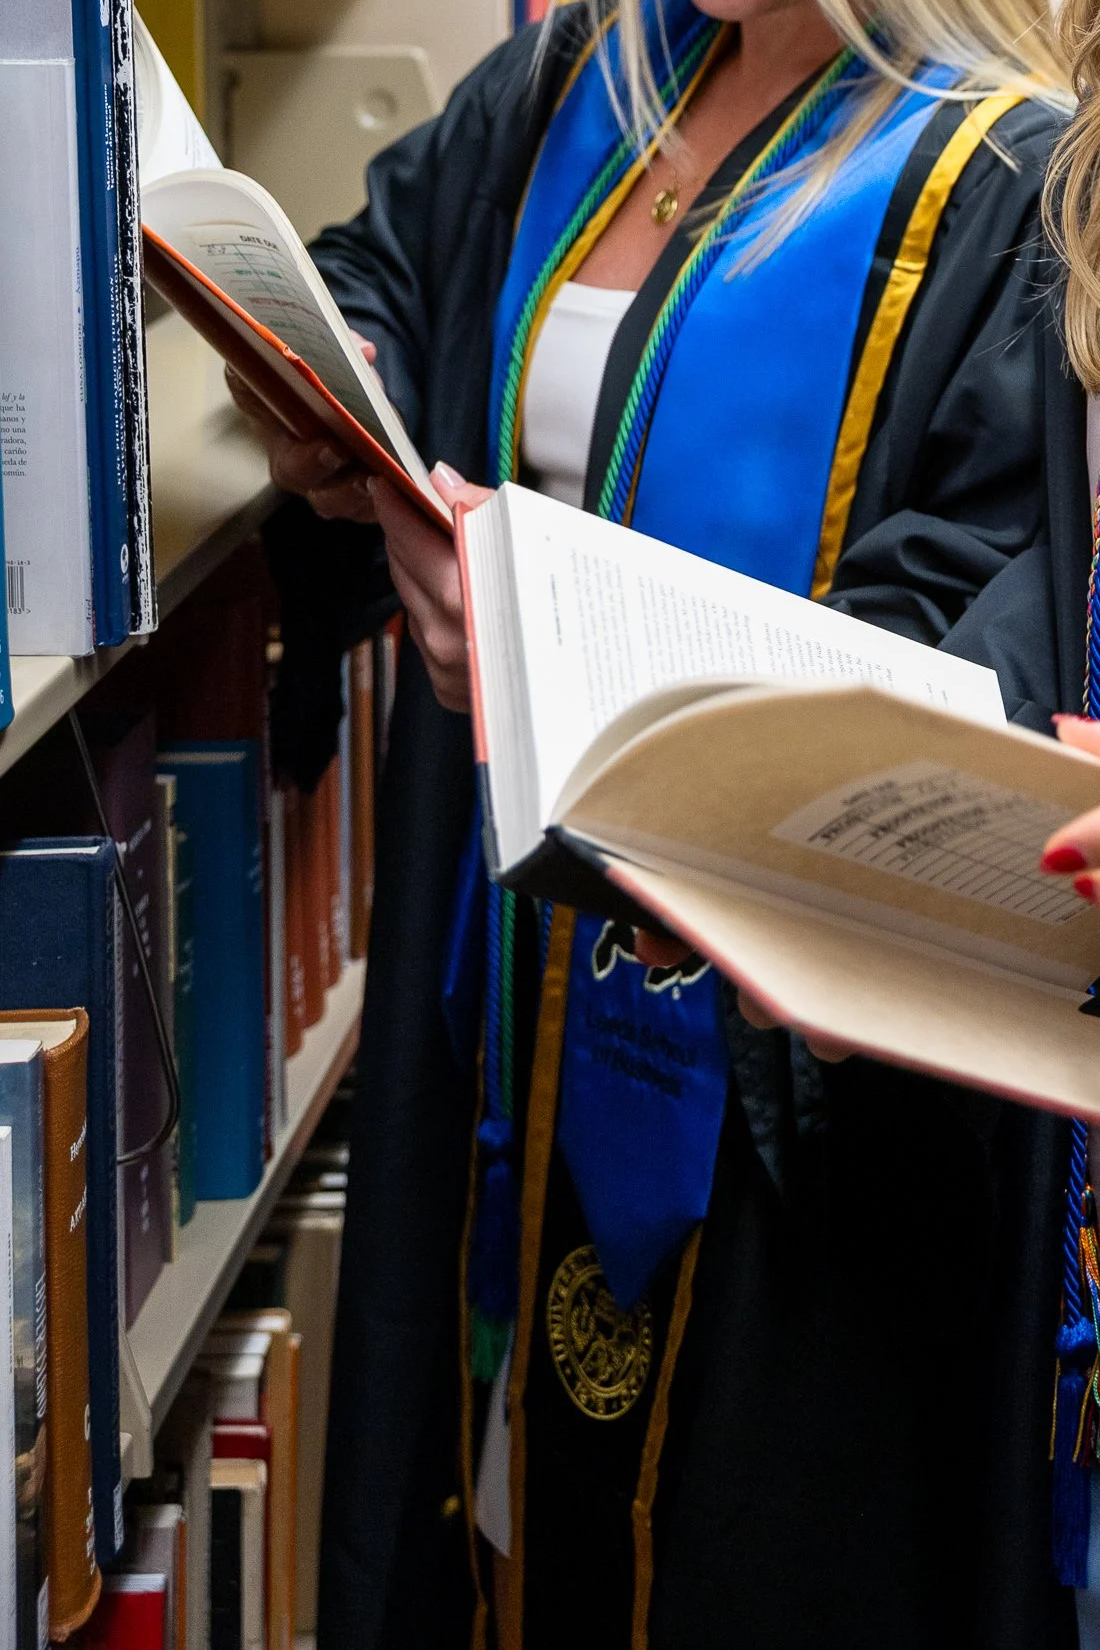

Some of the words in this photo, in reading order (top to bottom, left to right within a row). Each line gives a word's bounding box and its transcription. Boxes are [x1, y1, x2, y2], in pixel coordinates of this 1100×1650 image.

[239, 234, 261, 246] DATE
[16, 403, 26, 411] ha
[18, 457, 27, 466] de
[36, 1344, 48, 1419] ISLAND
